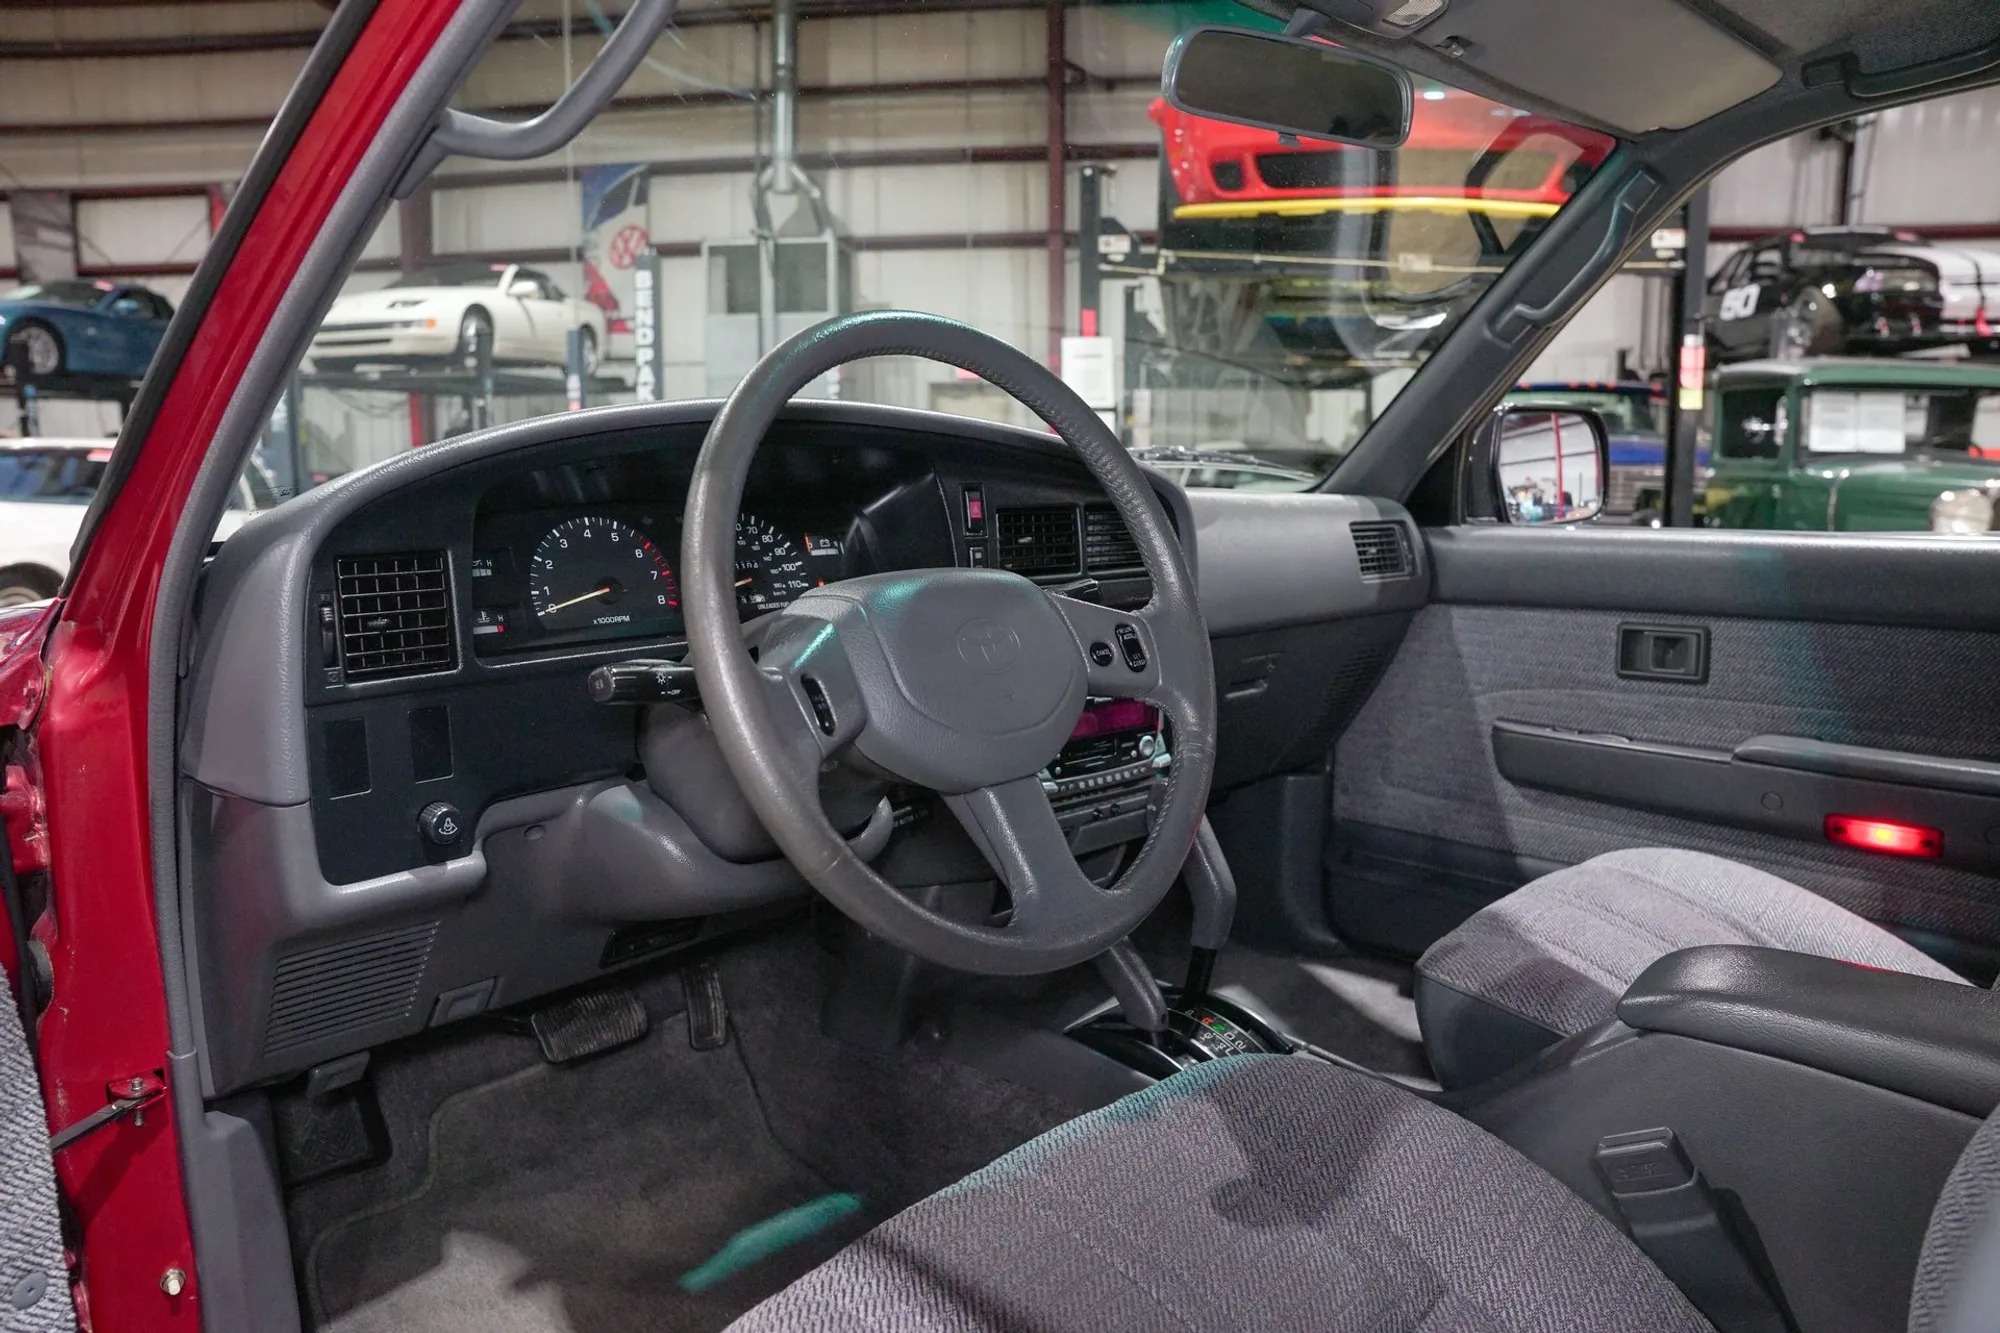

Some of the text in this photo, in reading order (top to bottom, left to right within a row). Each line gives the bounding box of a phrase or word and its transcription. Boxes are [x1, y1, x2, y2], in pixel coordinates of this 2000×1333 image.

[583, 529, 592, 538] 4
[611, 532, 620, 542] 5
[559, 539, 568, 549] 3
[761, 535, 774, 543] 80
[635, 549, 644, 559] 6
[774, 548, 786, 556] 90
[544, 559, 554, 570] 2
[781, 563, 797, 572] 100
[650, 570, 659, 581] 7
[787, 580, 802, 589] 110
[543, 586, 550, 596] 1
[657, 595, 667, 605] 8
